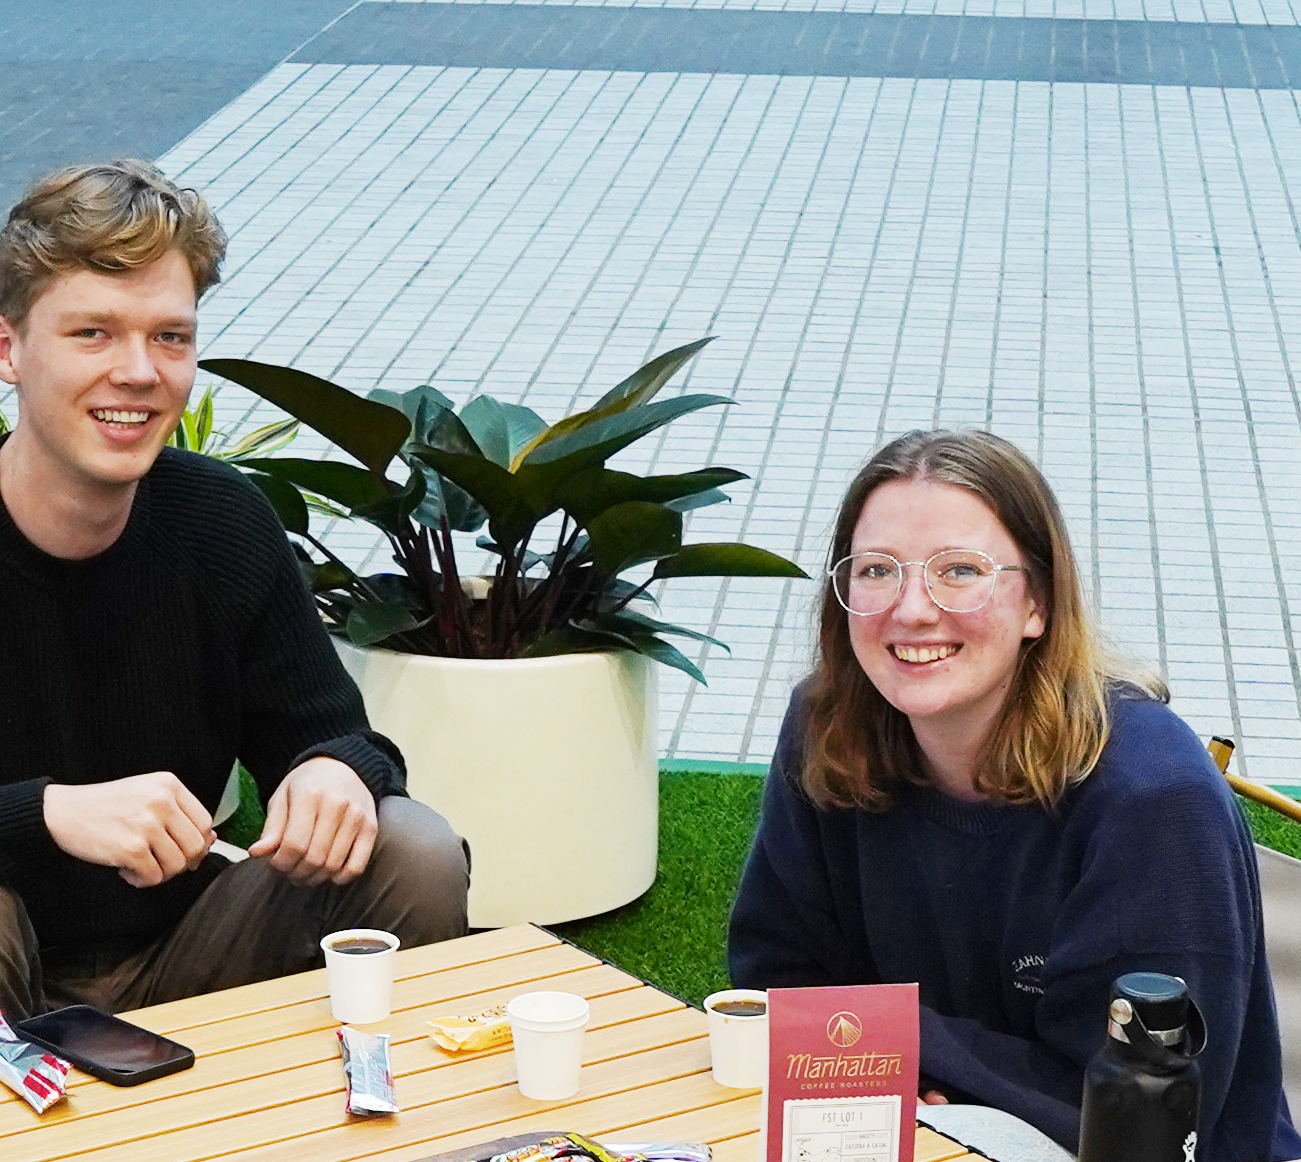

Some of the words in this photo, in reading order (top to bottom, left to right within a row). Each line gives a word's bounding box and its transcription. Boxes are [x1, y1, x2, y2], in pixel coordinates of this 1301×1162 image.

[787, 1051, 902, 1079] Manhattan
[801, 1082, 835, 1090] COFFEE
[840, 1080, 887, 1088] ROASTERS
[841, 1112, 855, 1122] LOT
